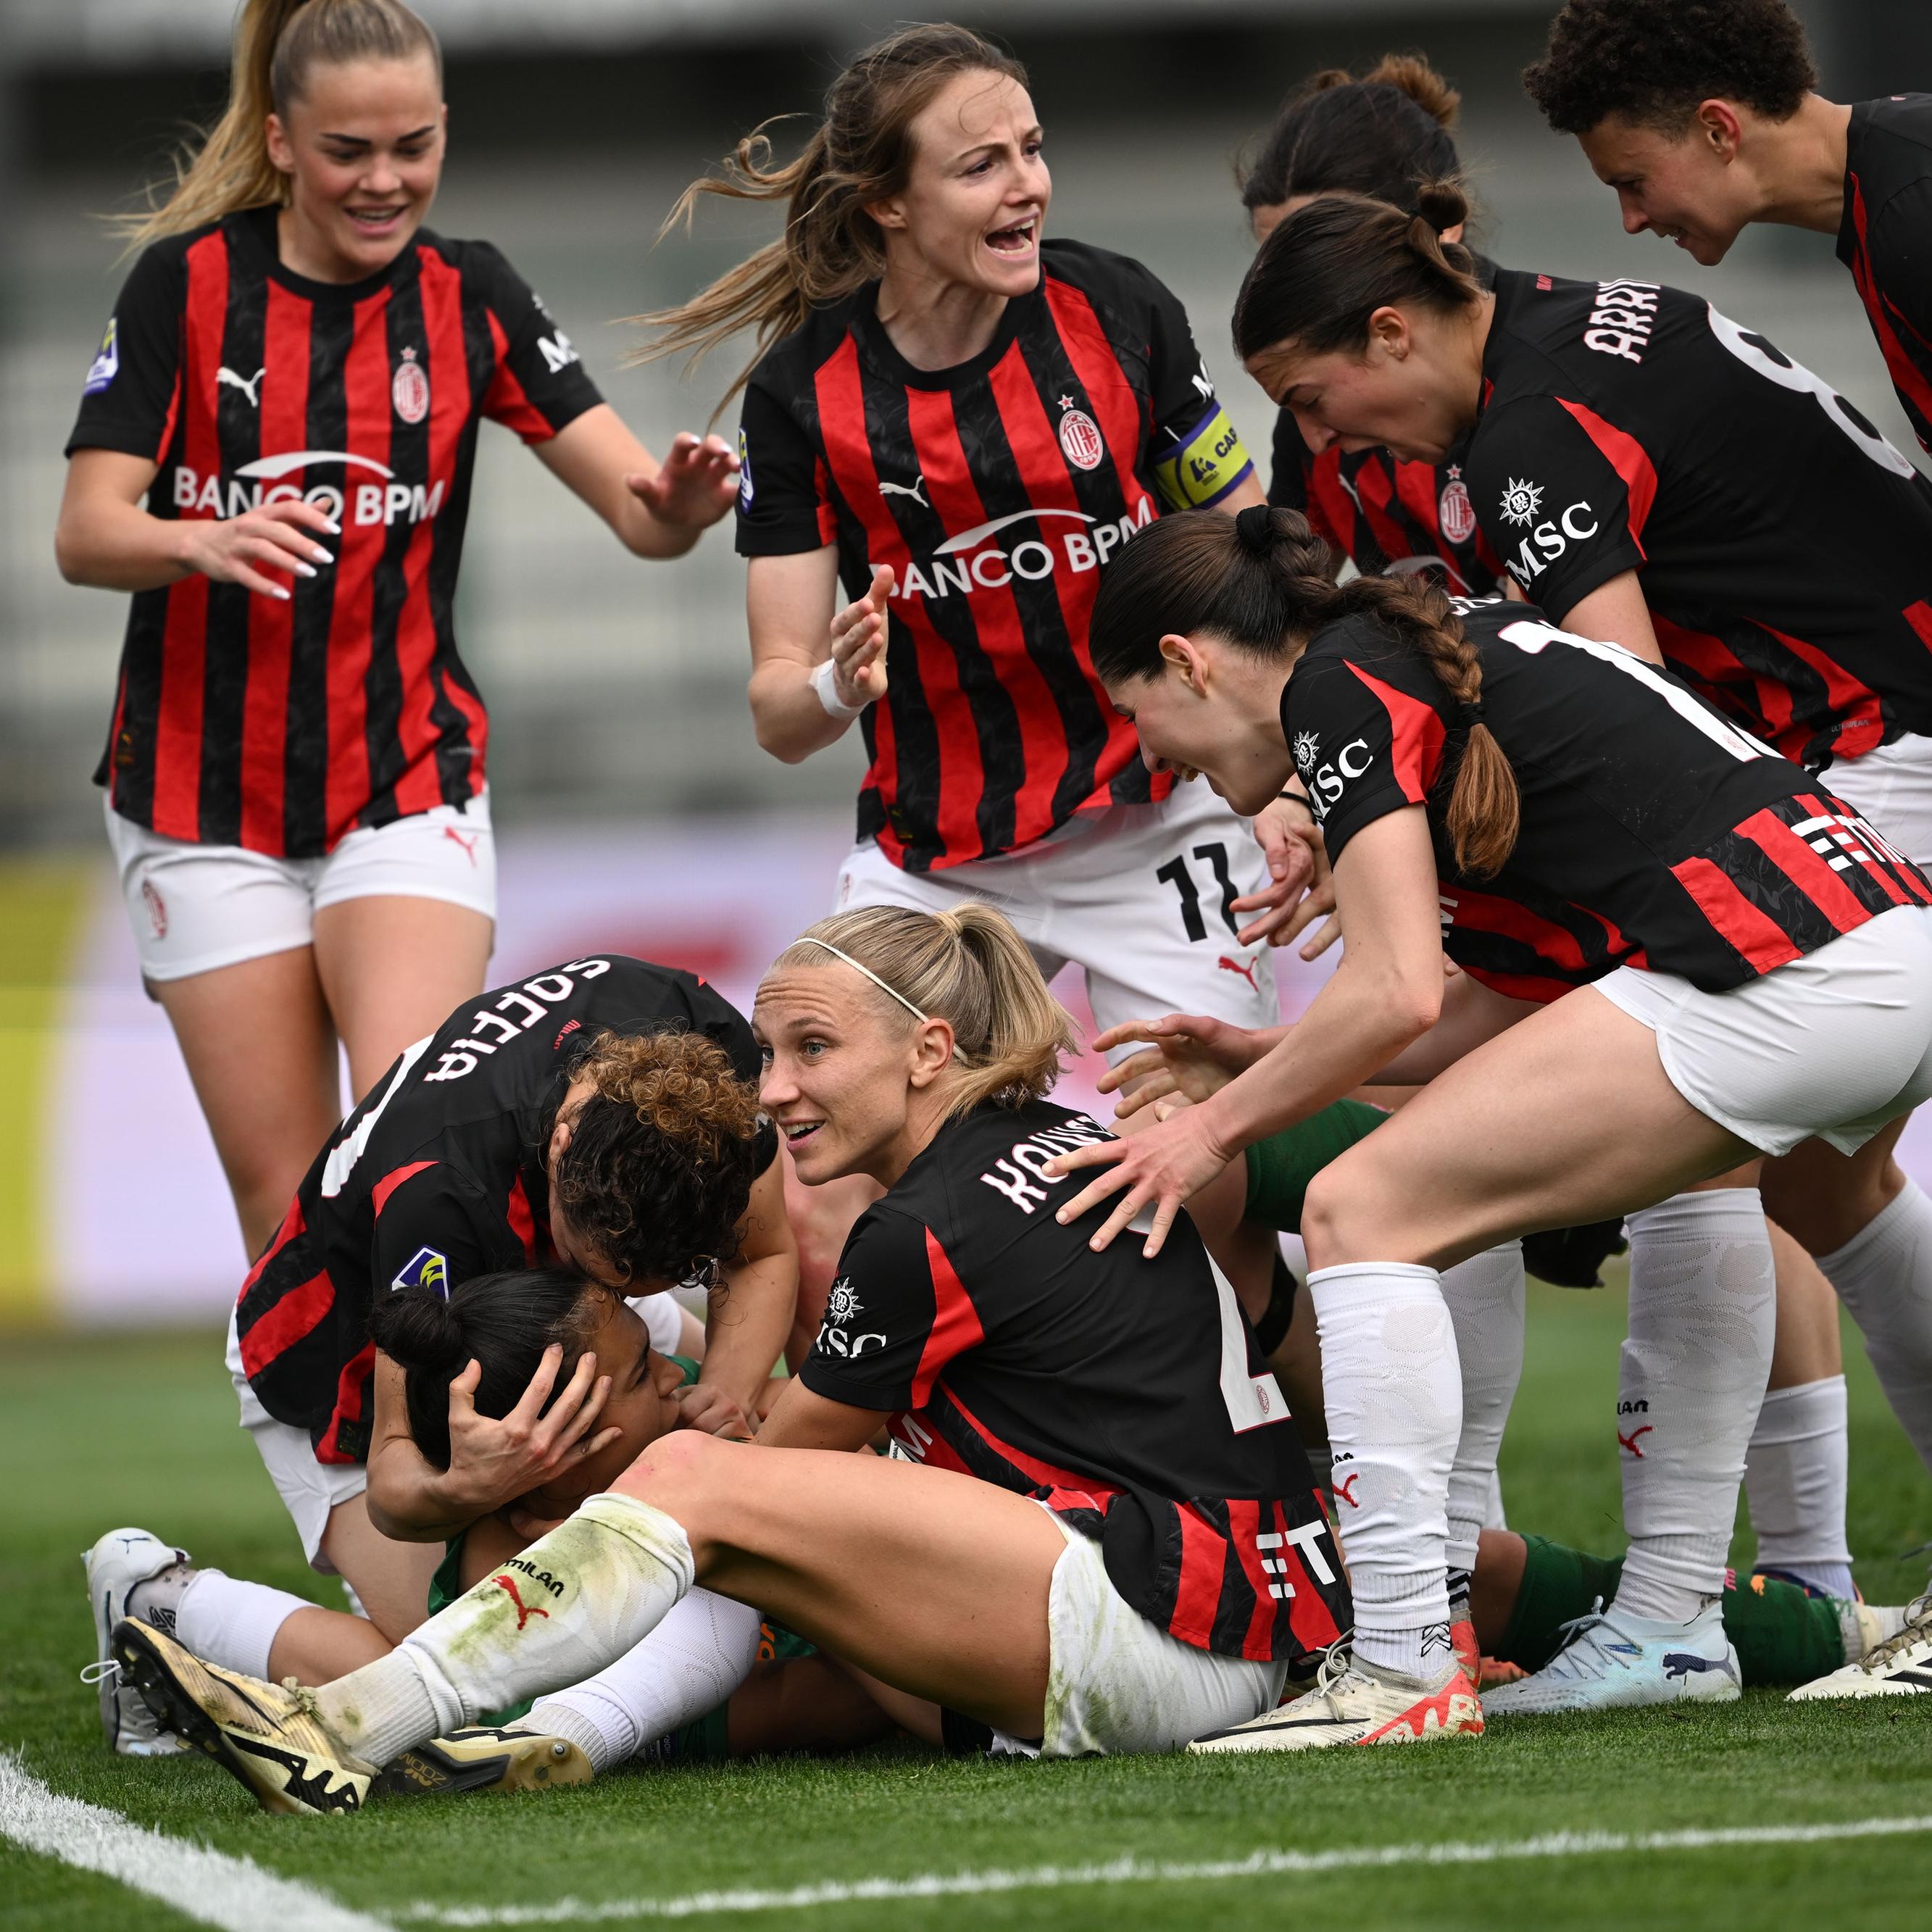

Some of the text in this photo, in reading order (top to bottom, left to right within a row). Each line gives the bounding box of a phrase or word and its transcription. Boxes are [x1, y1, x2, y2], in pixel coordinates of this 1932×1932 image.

[1707, 301, 1917, 480] 8
[354, 480, 445, 527] BPM
[1504, 501, 1599, 591] MSC
[422, 958, 611, 1081] SOFFIA
[504, 1559, 565, 1598] MILAN
[397, 1752, 447, 1786] ZOOM
